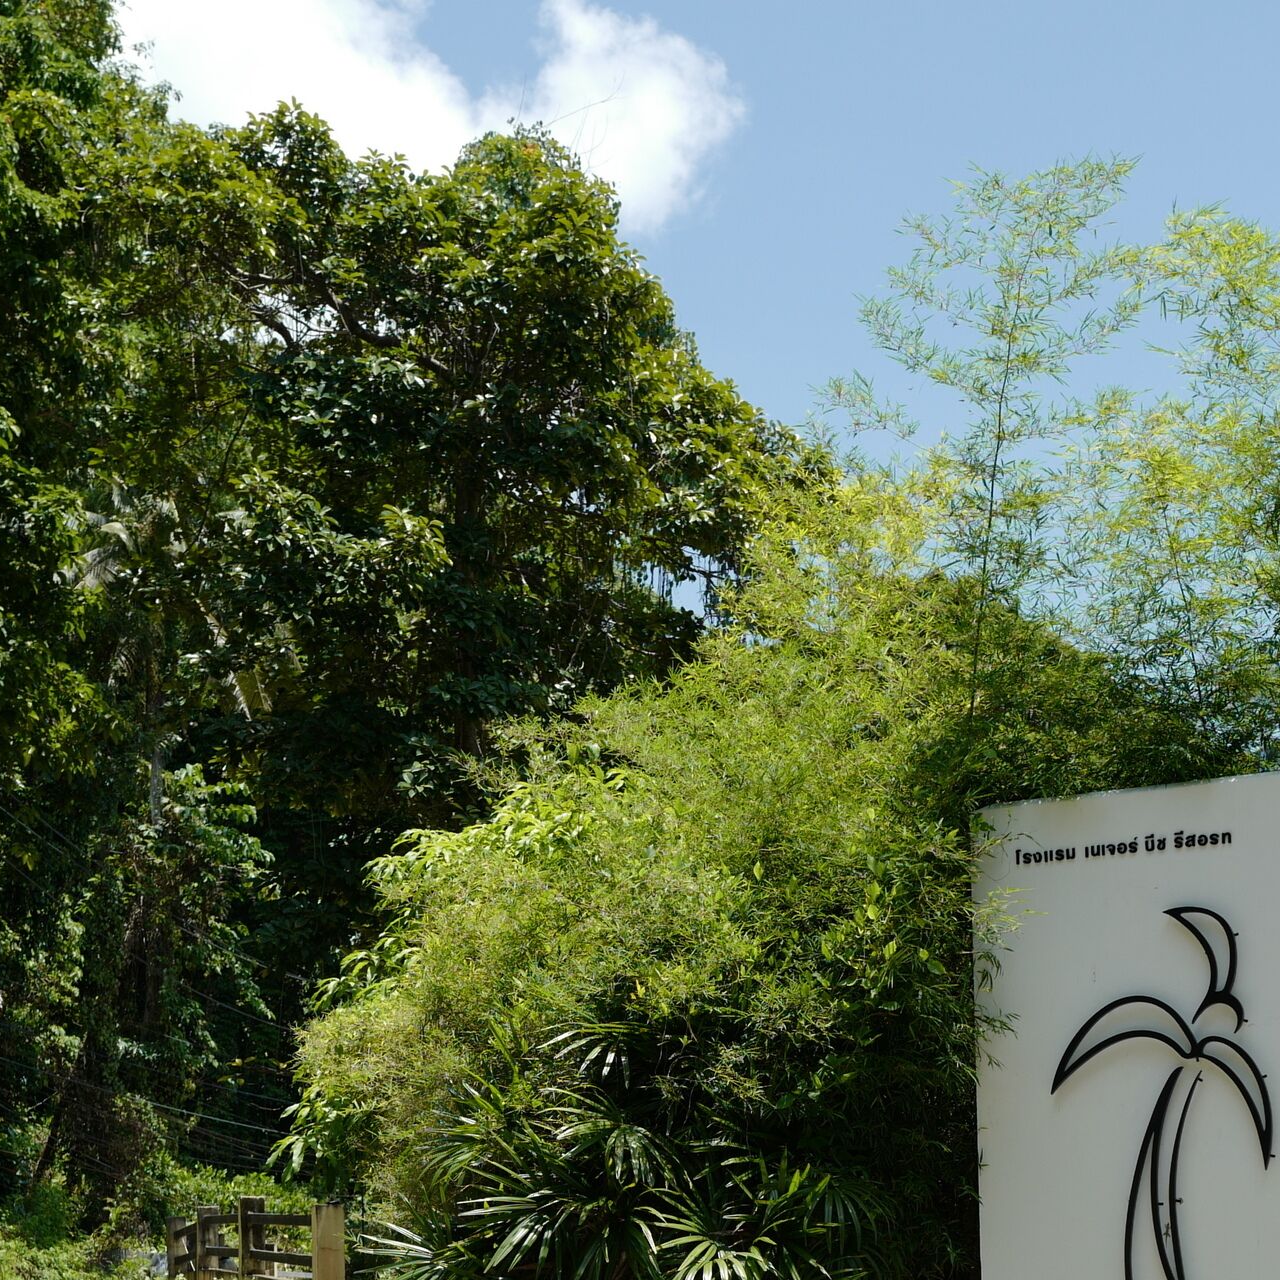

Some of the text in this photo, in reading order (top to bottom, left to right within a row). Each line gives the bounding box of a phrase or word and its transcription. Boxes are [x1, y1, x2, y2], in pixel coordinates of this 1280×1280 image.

[1015, 847, 1076, 865] โรงแรม
[1084, 836, 1138, 858] เนเจอร์
[1144, 833, 1167, 852] บีช
